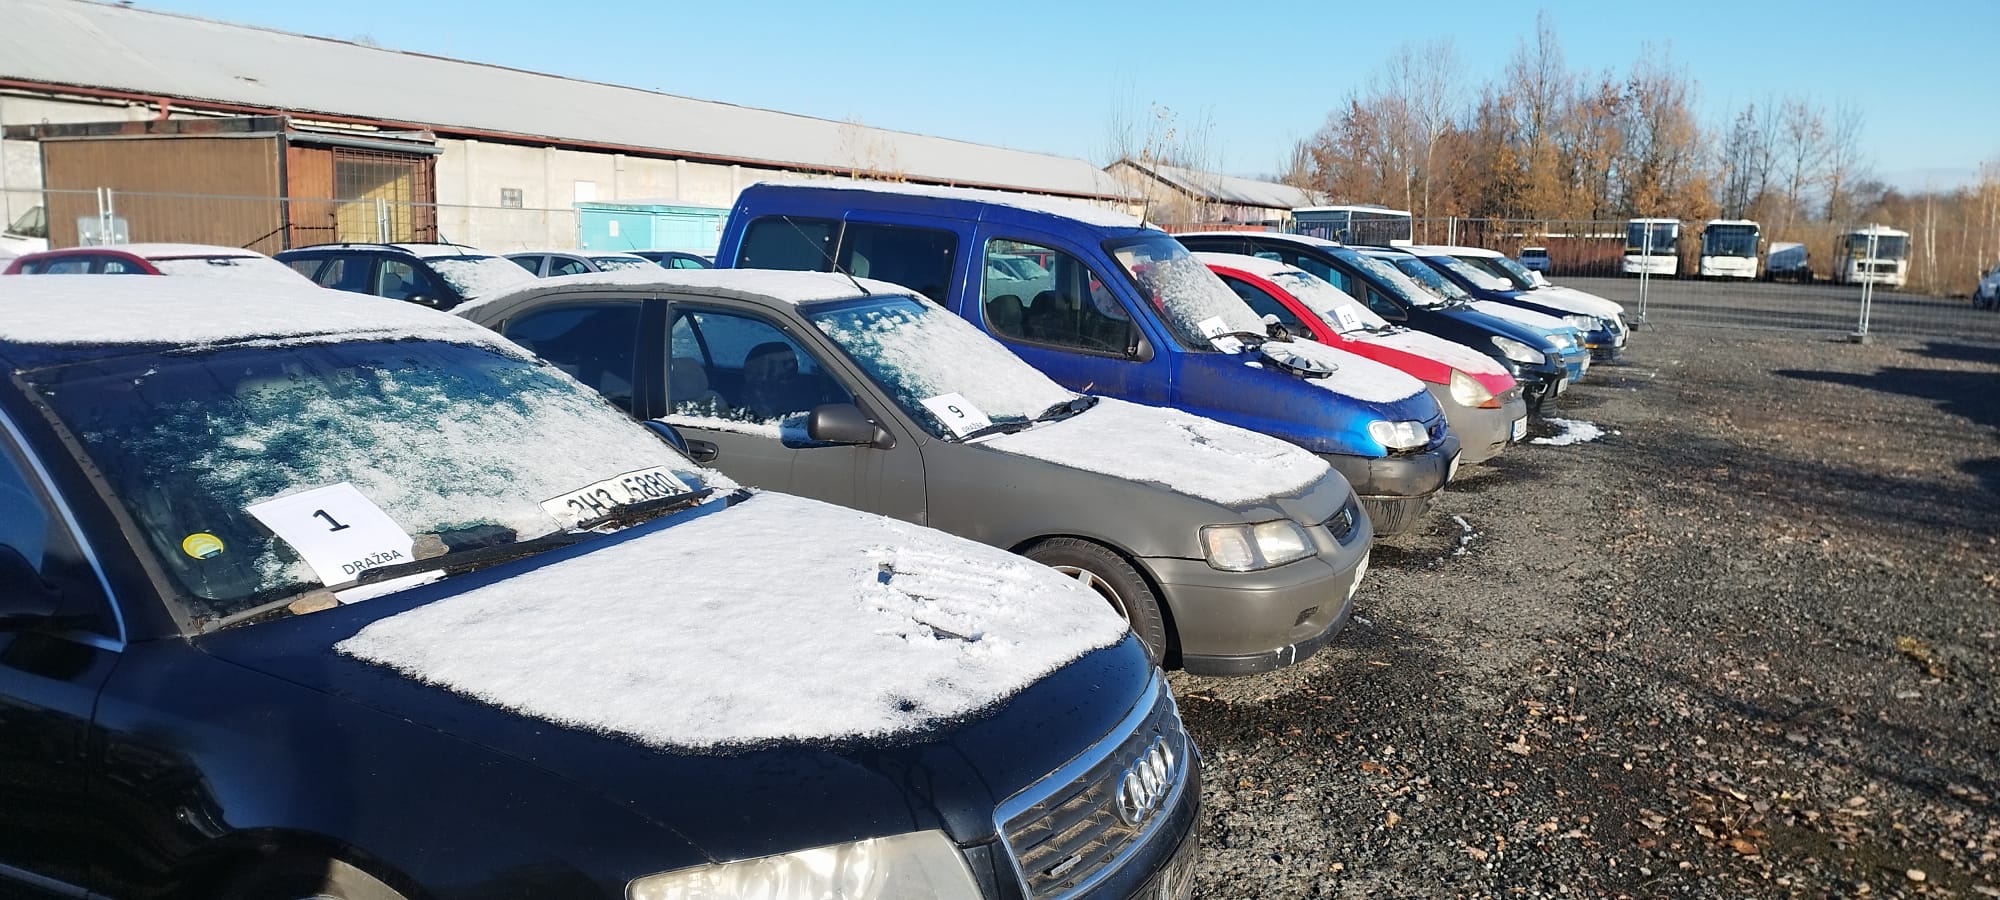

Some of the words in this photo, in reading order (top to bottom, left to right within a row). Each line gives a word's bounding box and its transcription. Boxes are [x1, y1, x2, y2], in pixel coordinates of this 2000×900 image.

[1343, 313, 1355, 324] 11
[948, 405, 965, 418] 9
[312, 509, 350, 532] 1
[341, 549, 404, 575] DRAŽBA
